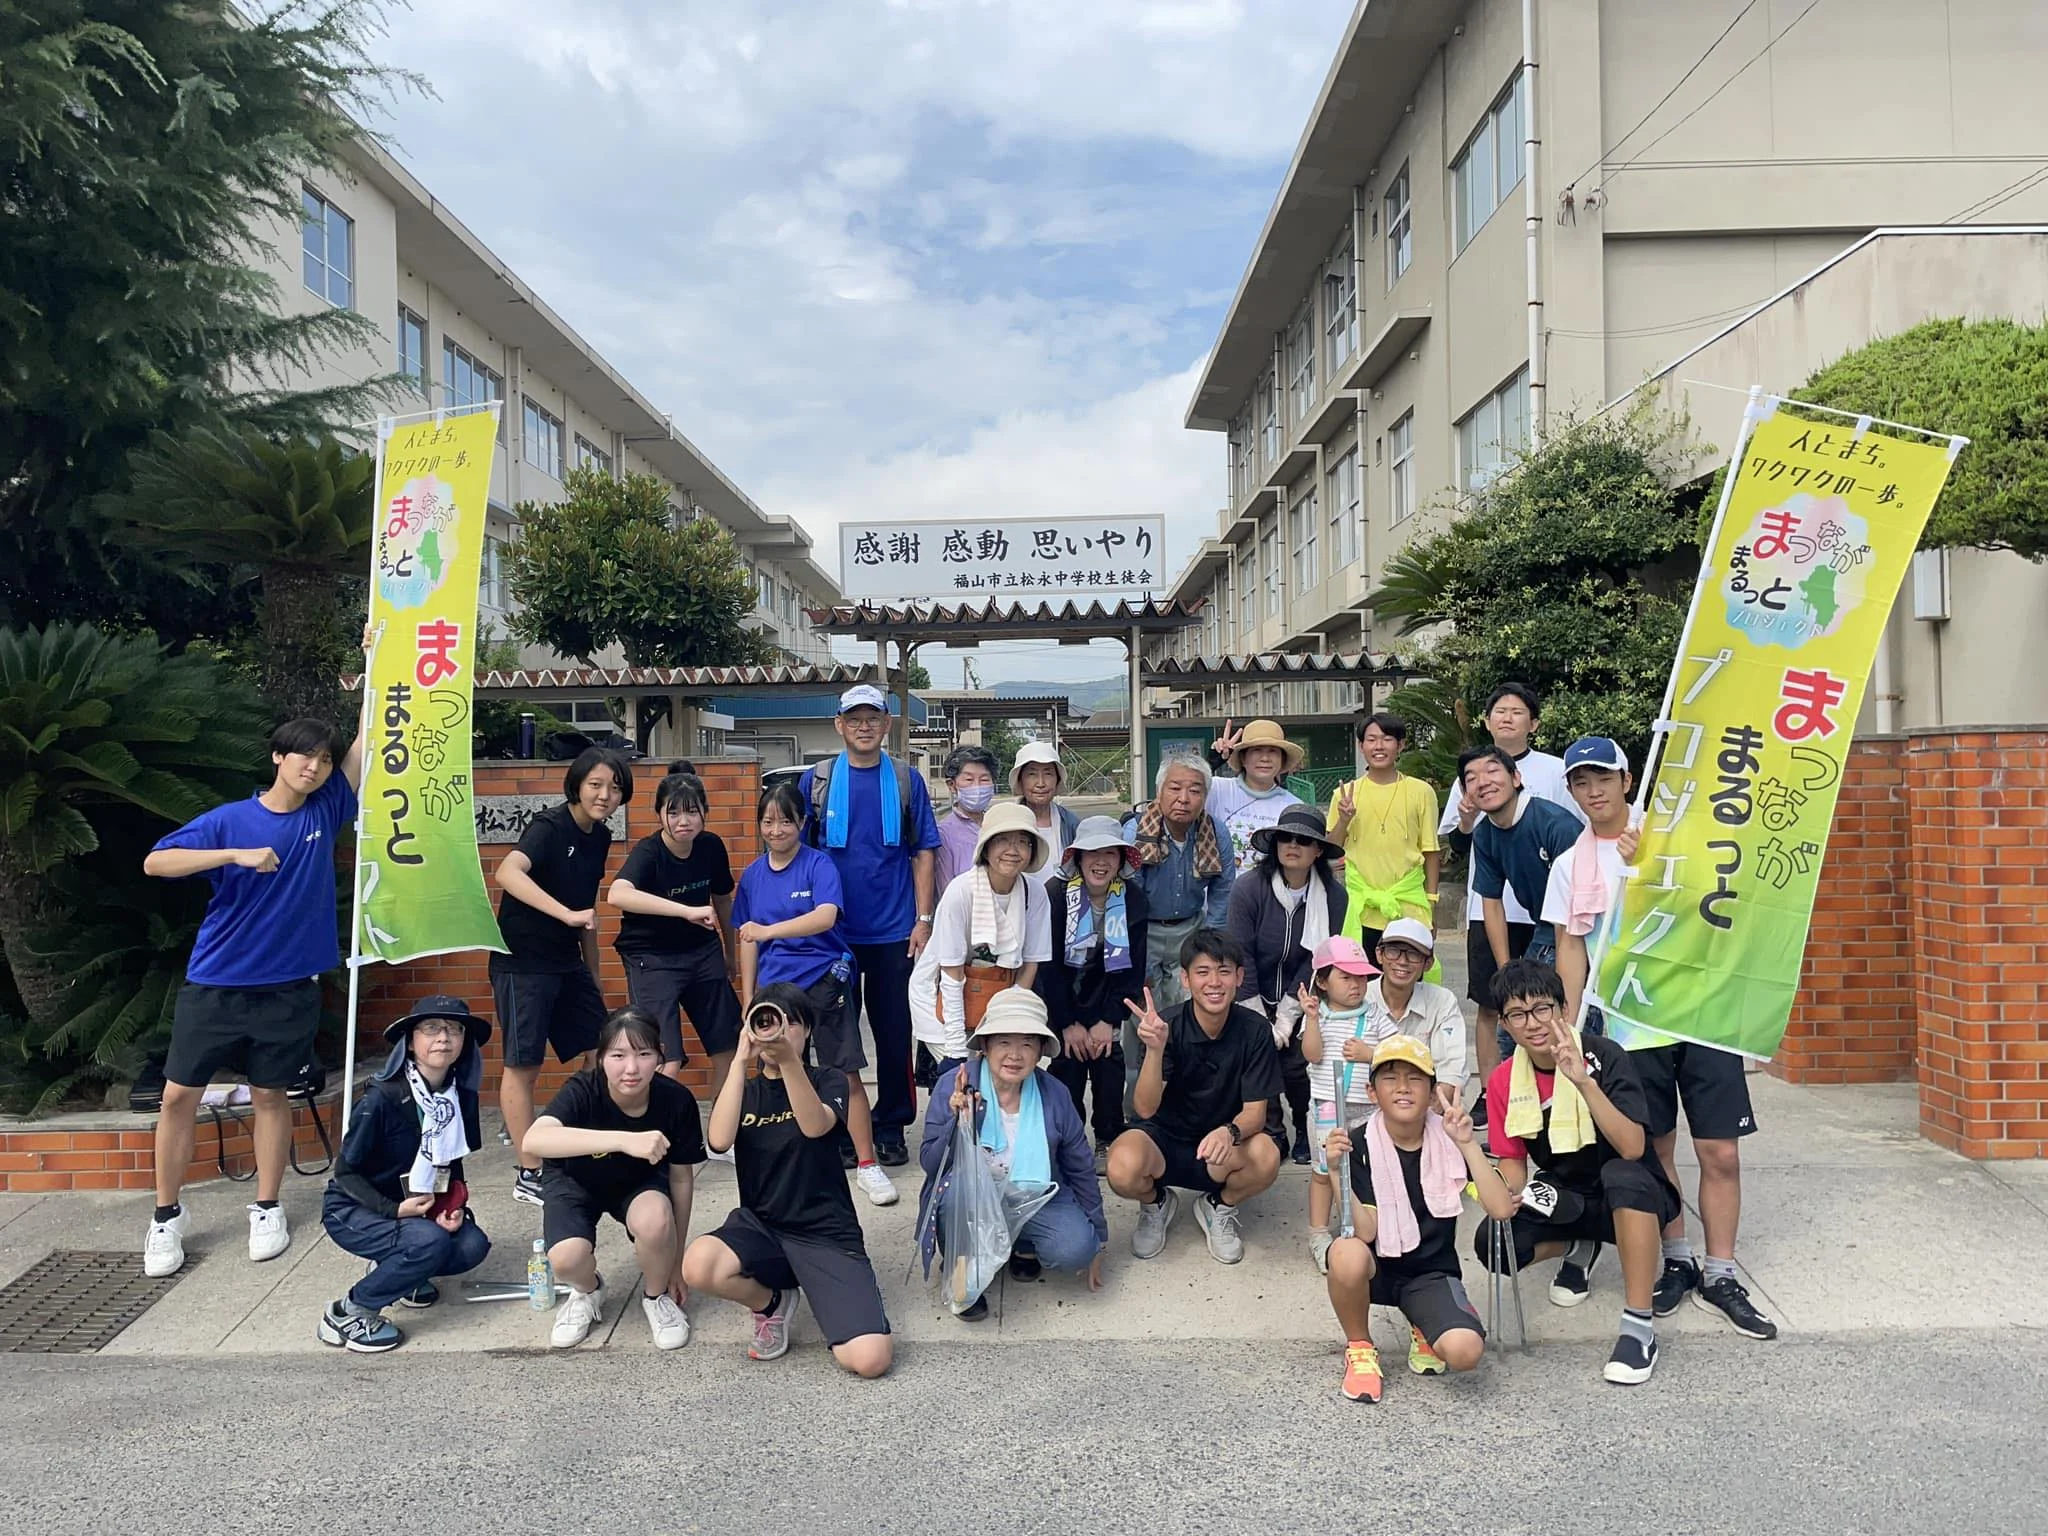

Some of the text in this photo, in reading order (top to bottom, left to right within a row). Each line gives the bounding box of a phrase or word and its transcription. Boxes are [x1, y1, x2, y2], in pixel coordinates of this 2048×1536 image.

[404, 427, 457, 449] 人とまち。
[1788, 430, 1886, 469] 人とまち。
[1751, 457, 1904, 509] ワクワクの一歩。
[854, 525, 1152, 565] 感謝 感動 思いやり
[1753, 511, 1871, 574] まつなが
[953, 568, 1153, 589] 福山市立松永中学校生徒会
[1730, 544, 1792, 611] まるっと
[412, 619, 469, 823] まつなが
[382, 681, 424, 865] まるっと
[1756, 667, 1846, 890] まつなが
[1611, 649, 1734, 1009] プロジェクト
[1699, 725, 1764, 930] まるっと
